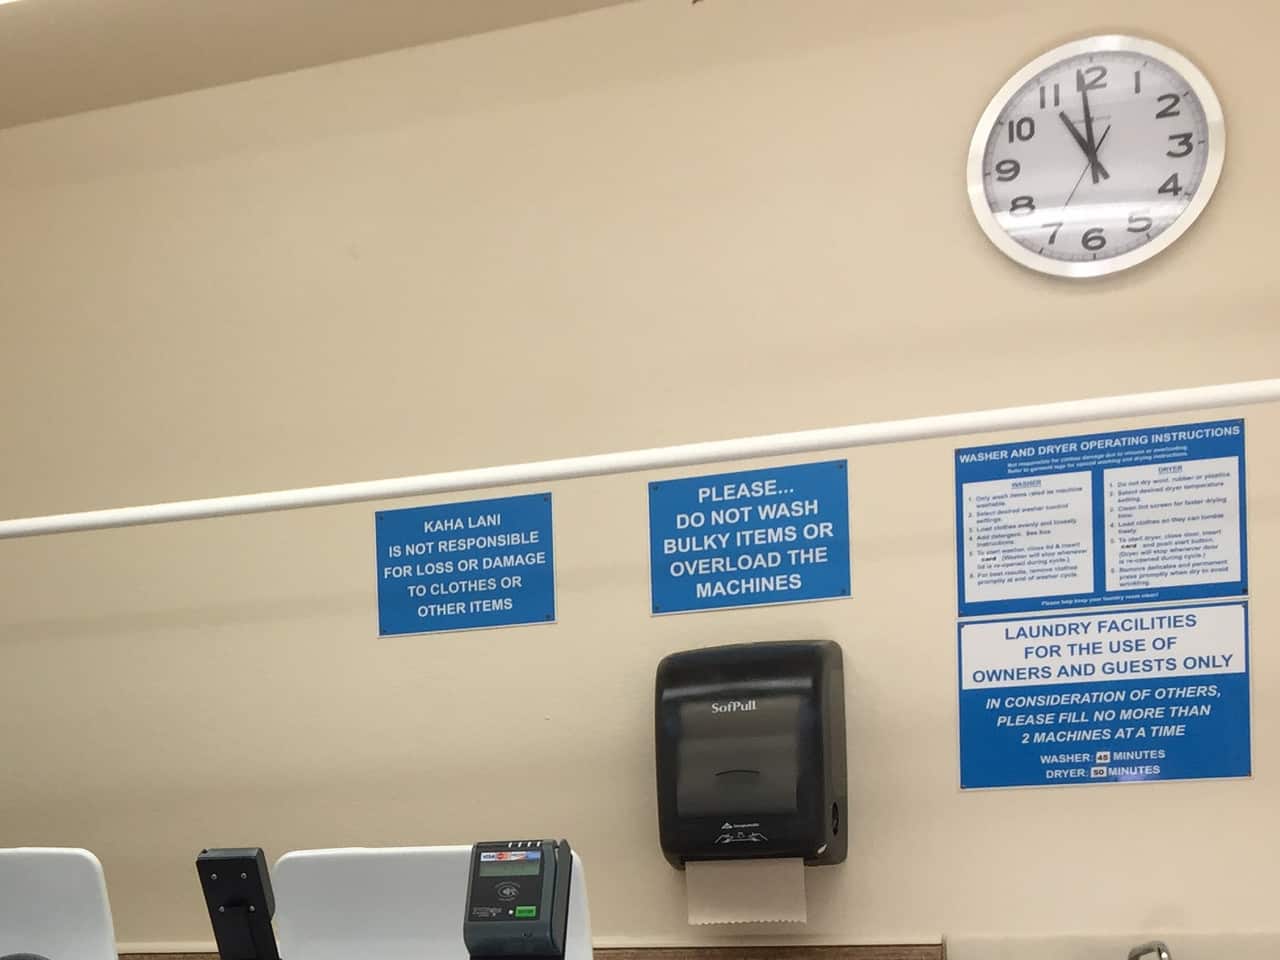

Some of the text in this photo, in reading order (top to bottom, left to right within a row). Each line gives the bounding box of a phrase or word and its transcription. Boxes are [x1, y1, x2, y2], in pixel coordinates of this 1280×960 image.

[1077, 66, 1107, 91] 12
[1135, 70, 1141, 93] 1
[1040, 83, 1060, 109] 11
[1156, 94, 1180, 118] 2
[1008, 117, 1035, 143] 10
[1167, 132, 1193, 157] 3
[996, 160, 1020, 182] 9
[1158, 173, 1182, 196] 4
[1010, 196, 1035, 216] 8
[1041, 223, 1063, 244] 7
[1127, 212, 1152, 233] 5
[1081, 228, 1106, 250] 6
[960, 451, 1008, 464] WASHER
[1011, 447, 1035, 458] AND
[1039, 442, 1077, 453] DRYER
[1080, 435, 1148, 450] OPERATING
[1151, 426, 1240, 443] INSTRUCTIONS
[698, 480, 794, 503] PLEASE...
[424, 514, 501, 533] KAHA LANI
[676, 500, 818, 529] DO NOT WASH
[389, 531, 539, 557] IS NOT RESPONSIBLE
[664, 523, 833, 554] BULKY ITEMS OR
[384, 552, 545, 578] FOR LOSS OR DAMAGE
[670, 547, 828, 577] OVERLOAD THE
[408, 576, 522, 597] TO CLOTHES OR
[697, 574, 802, 598] MACHINES
[418, 598, 512, 617] OTHER ITEMS
[1005, 614, 1197, 640] LAUNDRY FACILITIES
[1024, 637, 1177, 659] FOR THE USE OF
[973, 654, 1233, 683] OWNERS AND GUESTS ONLY
[712, 700, 756, 714] SofPull
[986, 685, 1220, 709] IN CONSIDERATION OF OTHERS,
[997, 704, 1211, 727] PLEASE FILL NO MORE THAN
[1022, 725, 1186, 744] 2 MACHINES AT A TIME
[1040, 753, 1093, 764] WASHER:
[1113, 750, 1166, 760] MINUTES
[1108, 765, 1160, 776] MINUTES
